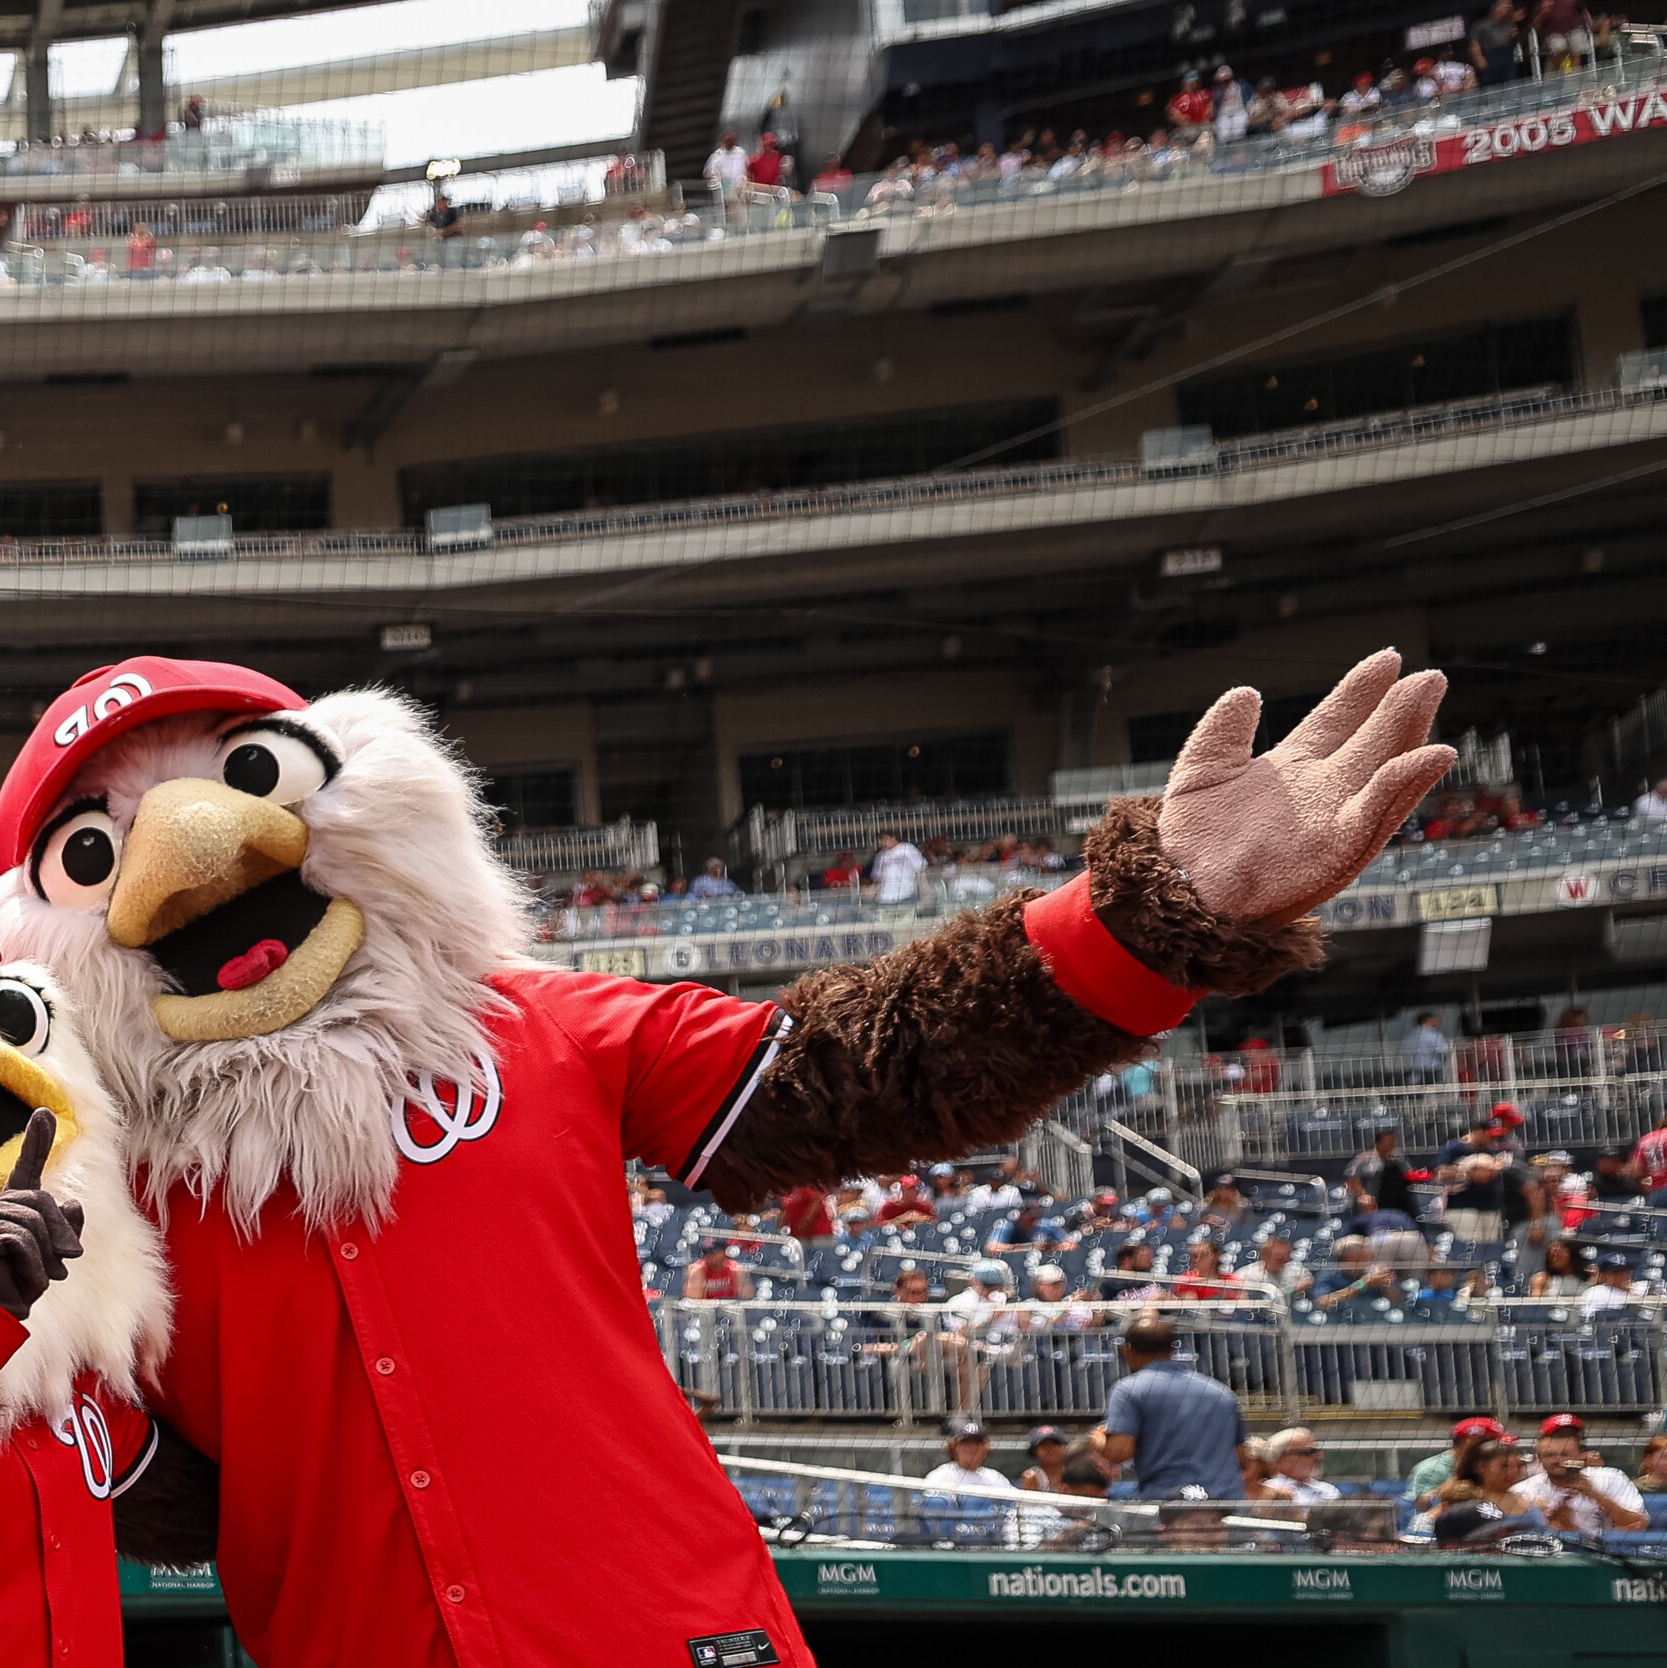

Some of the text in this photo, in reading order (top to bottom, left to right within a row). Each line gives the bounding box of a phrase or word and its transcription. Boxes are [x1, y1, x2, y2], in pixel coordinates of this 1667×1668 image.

[1462, 111, 1578, 164] 2005
[1566, 879, 1589, 899] W
[1319, 894, 1397, 923] ON
[704, 930, 896, 970] LEONARD
[818, 1563, 878, 1584] MGM
[988, 1565, 1188, 1598] nationals.com
[1293, 1568, 1352, 1590] MGM
[1445, 1568, 1503, 1590] MGM
